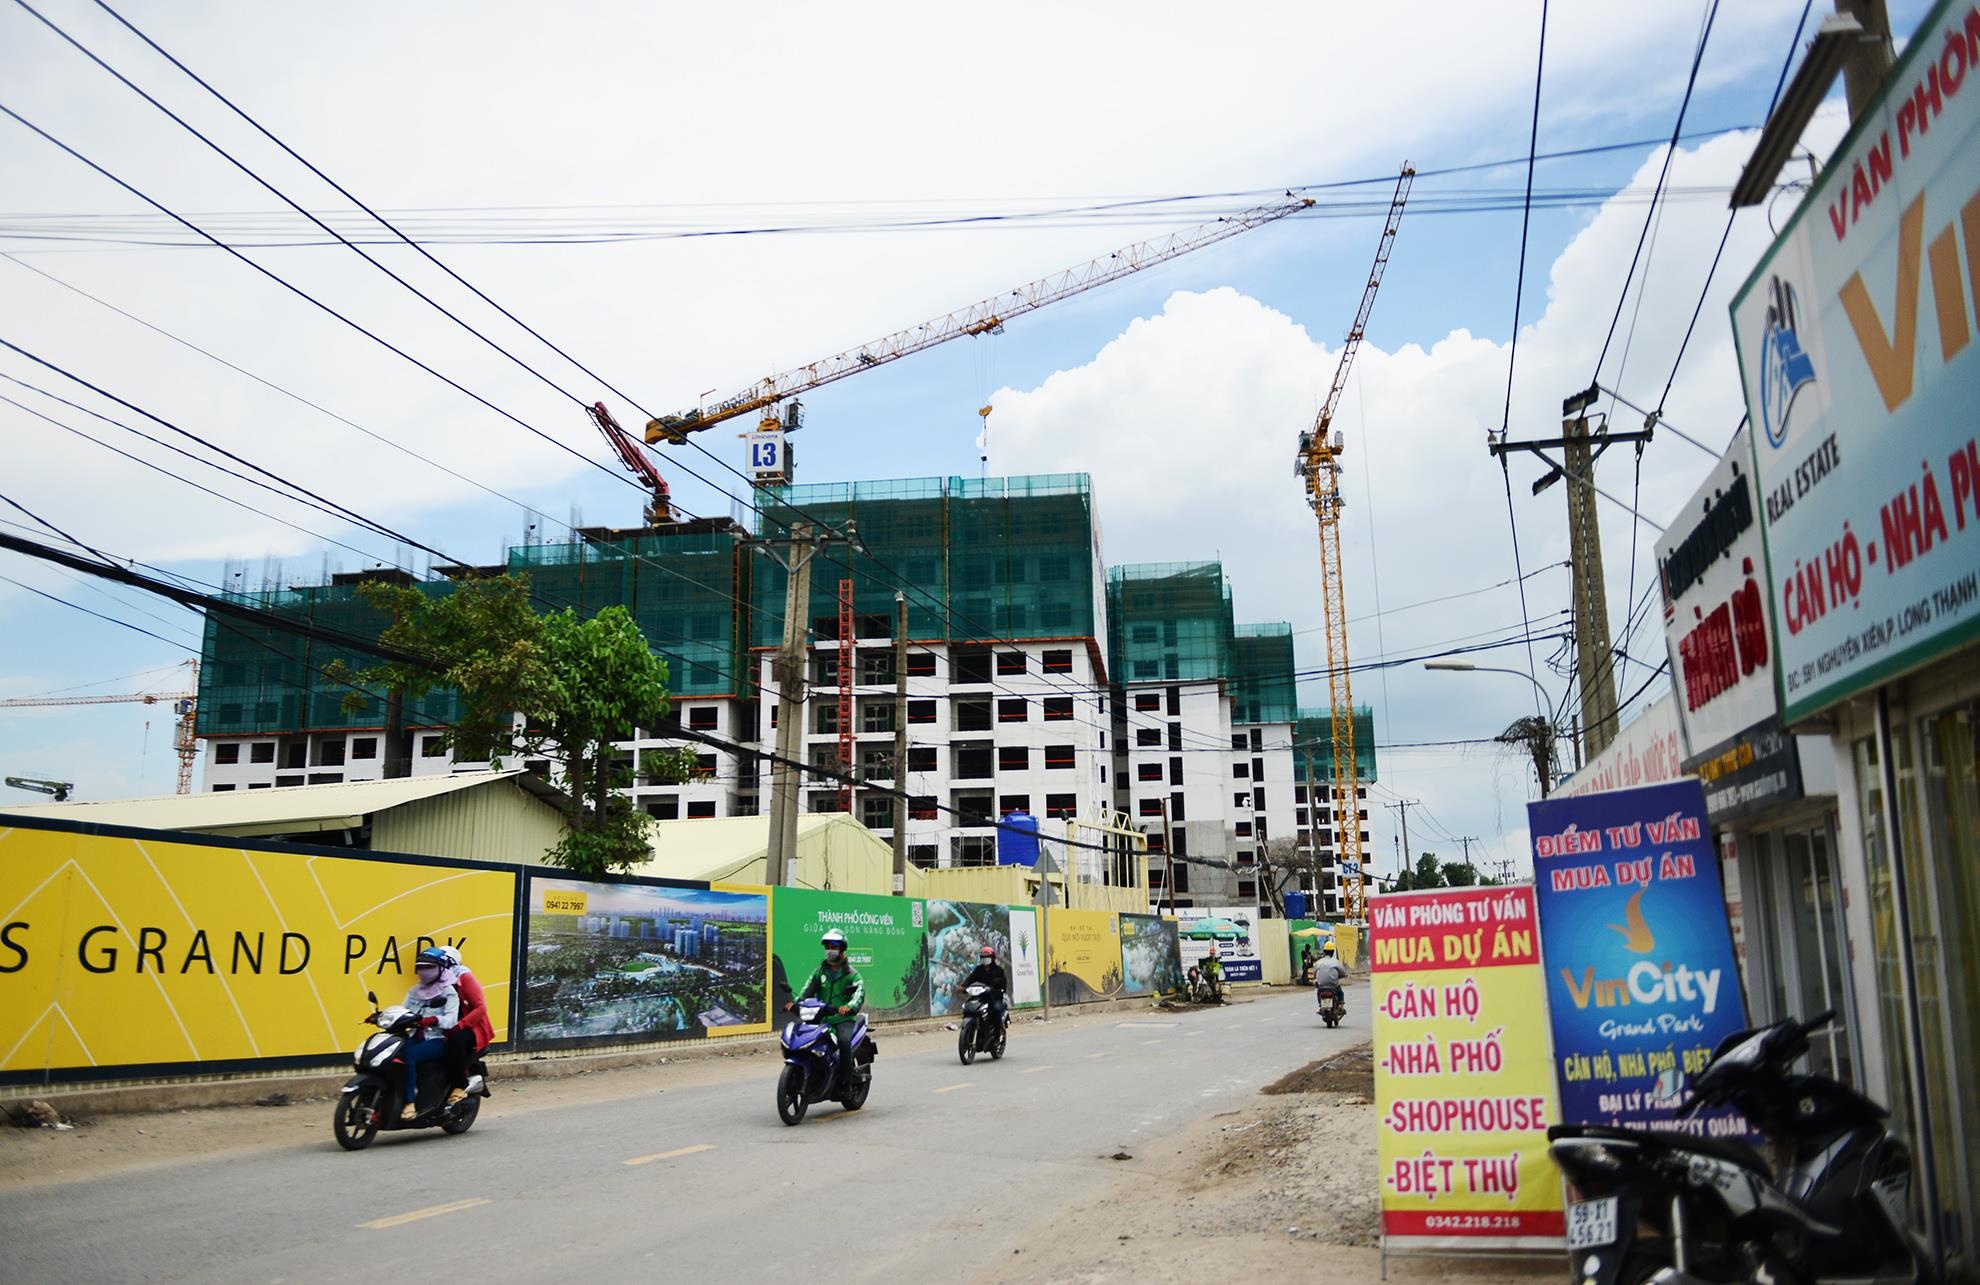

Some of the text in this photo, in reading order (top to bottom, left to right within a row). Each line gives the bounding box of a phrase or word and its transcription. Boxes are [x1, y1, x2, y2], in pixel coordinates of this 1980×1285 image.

[1829, 130, 1893, 243] VĂN
[752, 442, 777, 467] L3
[1766, 431, 1841, 527] REAL ESTATE
[1825, 520, 1862, 609] HỘ
[1880, 458, 1948, 575] NHÀ
[1897, 596, 1931, 636] LONG
[1536, 811, 1701, 858] ĐIỂM TƯ VẤN
[1551, 851, 1696, 892] MUA DỰ ÁN
[1374, 891, 1527, 929] VĂN PHÒNG TƯ VẤN
[78, 925, 312, 975] GRAND
[1375, 924, 1532, 966] MUA DỰ ÁN
[1446, 977, 1479, 1022] HỘ
[1561, 960, 1721, 1014] VinCity
[1599, 1013, 1704, 1039] Grand Park
[1450, 1028, 1502, 1073] PHỐ
[1564, 1052, 1590, 1082] CĂN
[1618, 1050, 1646, 1078] NHÀ
[1625, 1088, 1641, 1111] LÝ
[1464, 1152, 1518, 1200] THỰ
[1425, 1215, 1521, 1228] 0342.218.218
